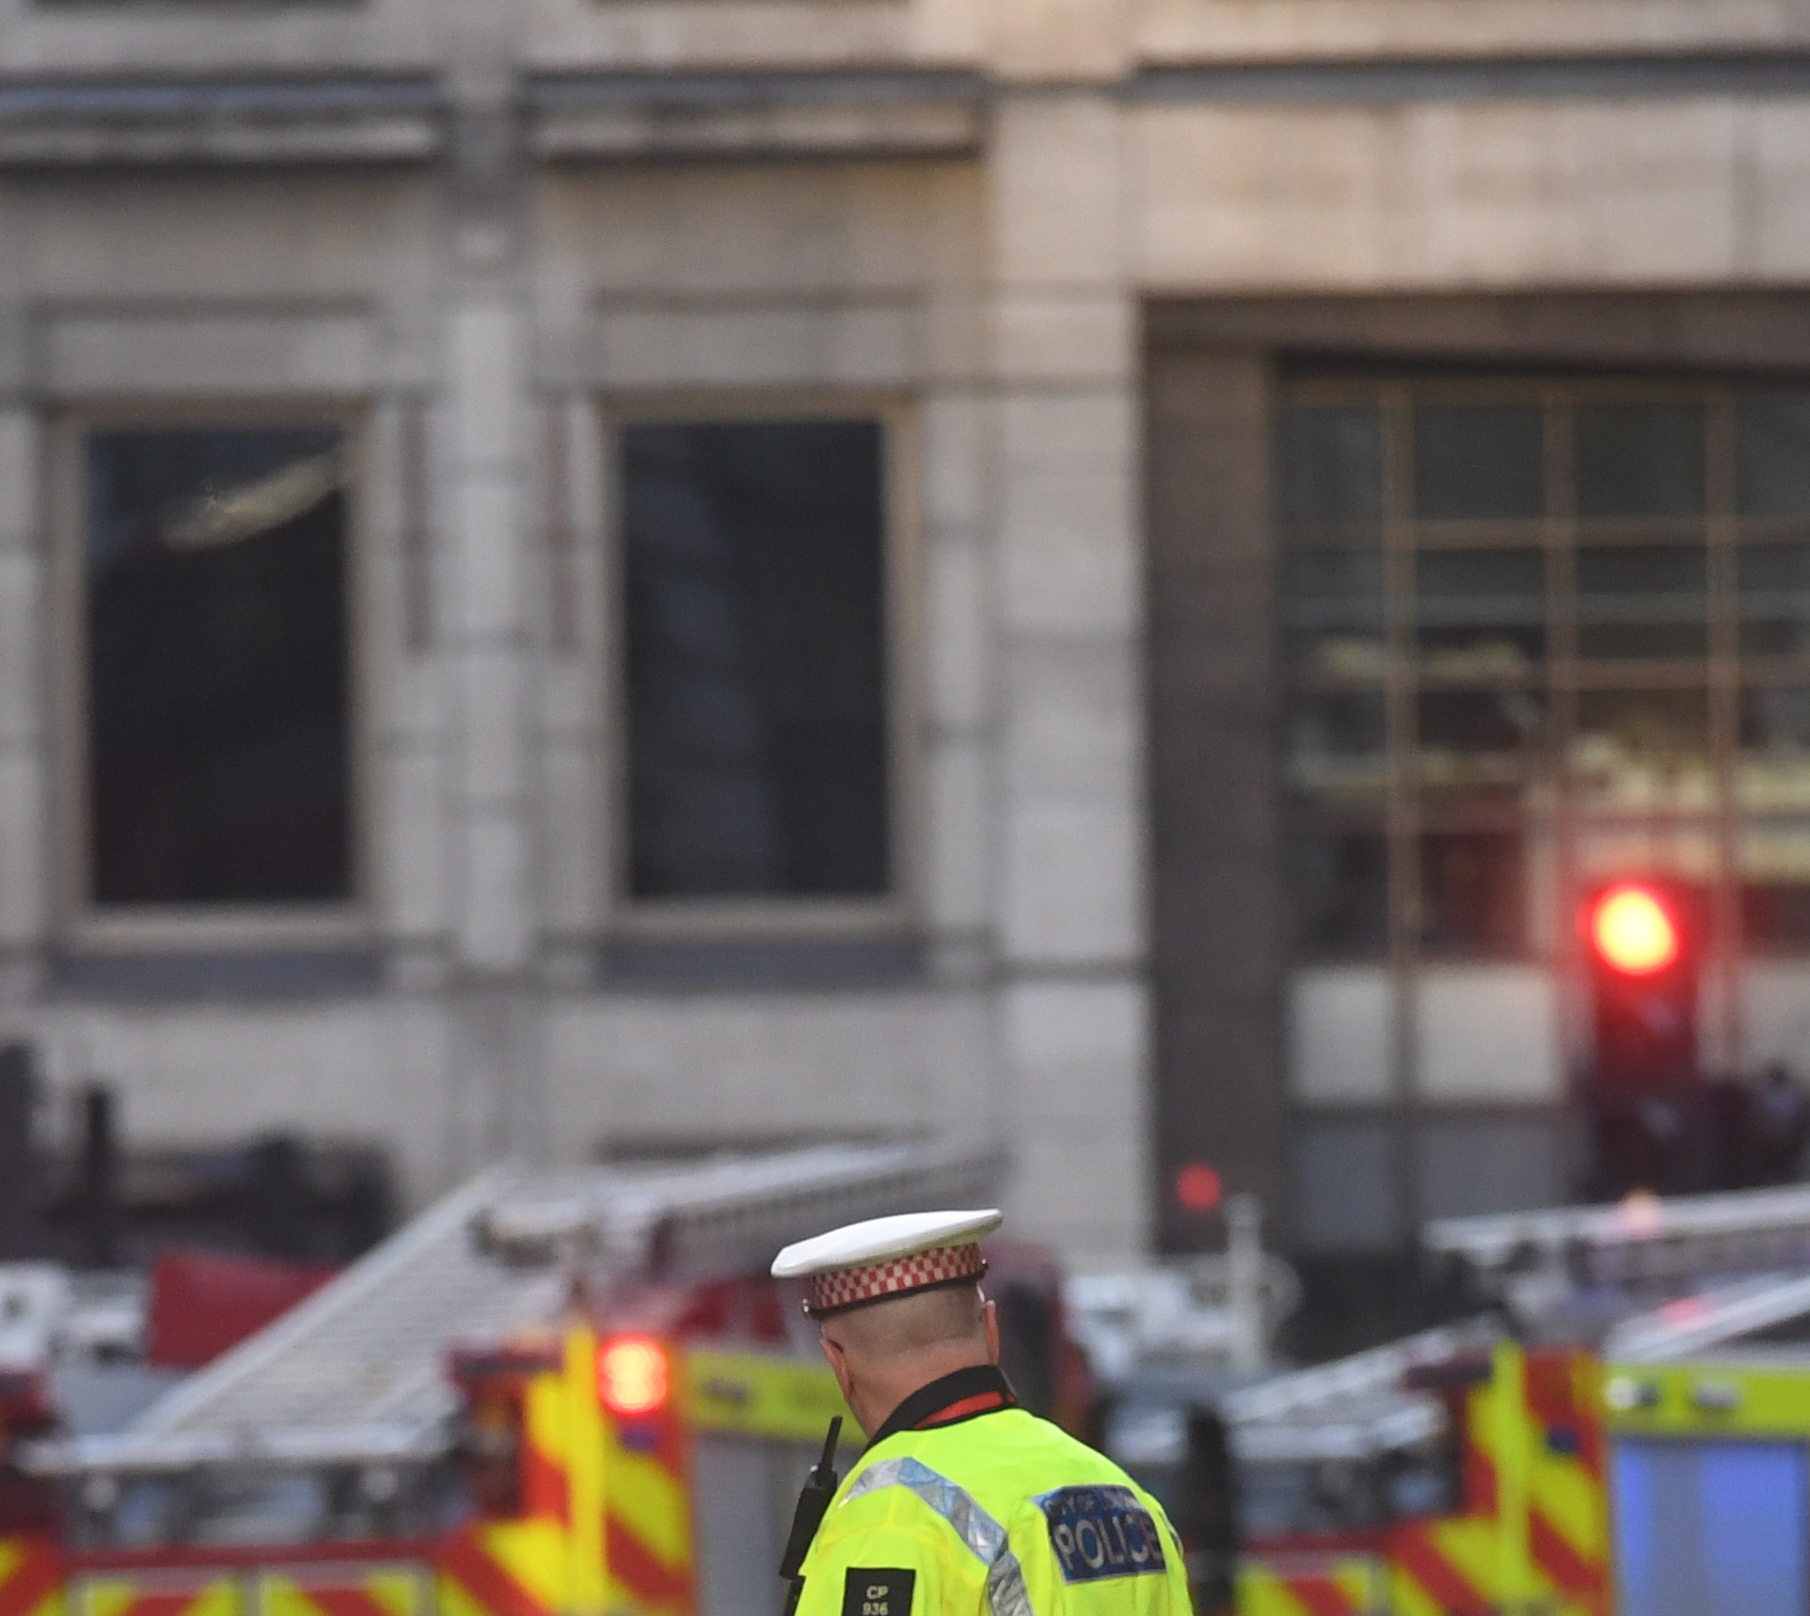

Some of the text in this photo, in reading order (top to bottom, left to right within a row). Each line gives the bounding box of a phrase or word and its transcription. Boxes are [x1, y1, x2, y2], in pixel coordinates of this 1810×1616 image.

[1053, 1515, 1162, 1569] POLICE
[866, 1585, 889, 1600] CP
[862, 1602, 889, 1616] 936
